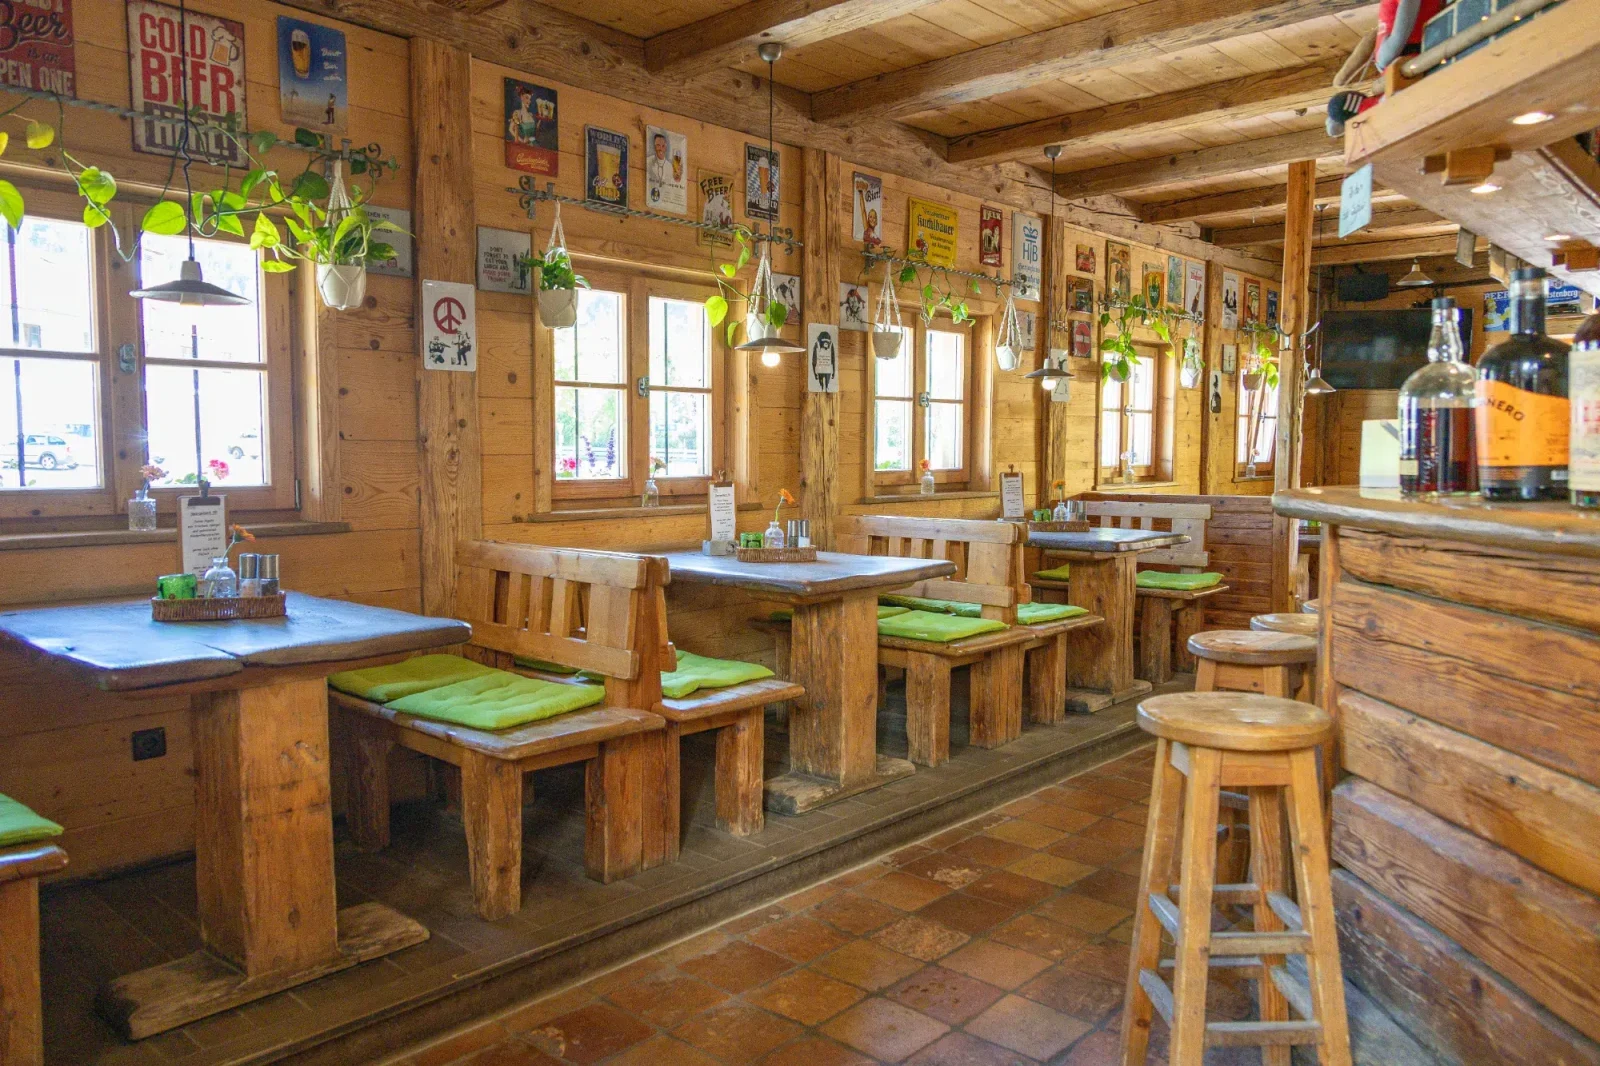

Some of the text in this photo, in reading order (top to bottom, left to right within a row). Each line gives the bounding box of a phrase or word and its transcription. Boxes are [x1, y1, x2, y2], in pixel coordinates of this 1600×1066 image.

[139, 12, 207, 61] COLD
[0, 57, 74, 97] PEN ONE
[140, 48, 236, 114] BEER
[700, 176, 724, 196] FREE
[706, 182, 734, 204] BEER!
[865, 186, 881, 202] Bier!
[1546, 289, 1579, 299] stenberg
